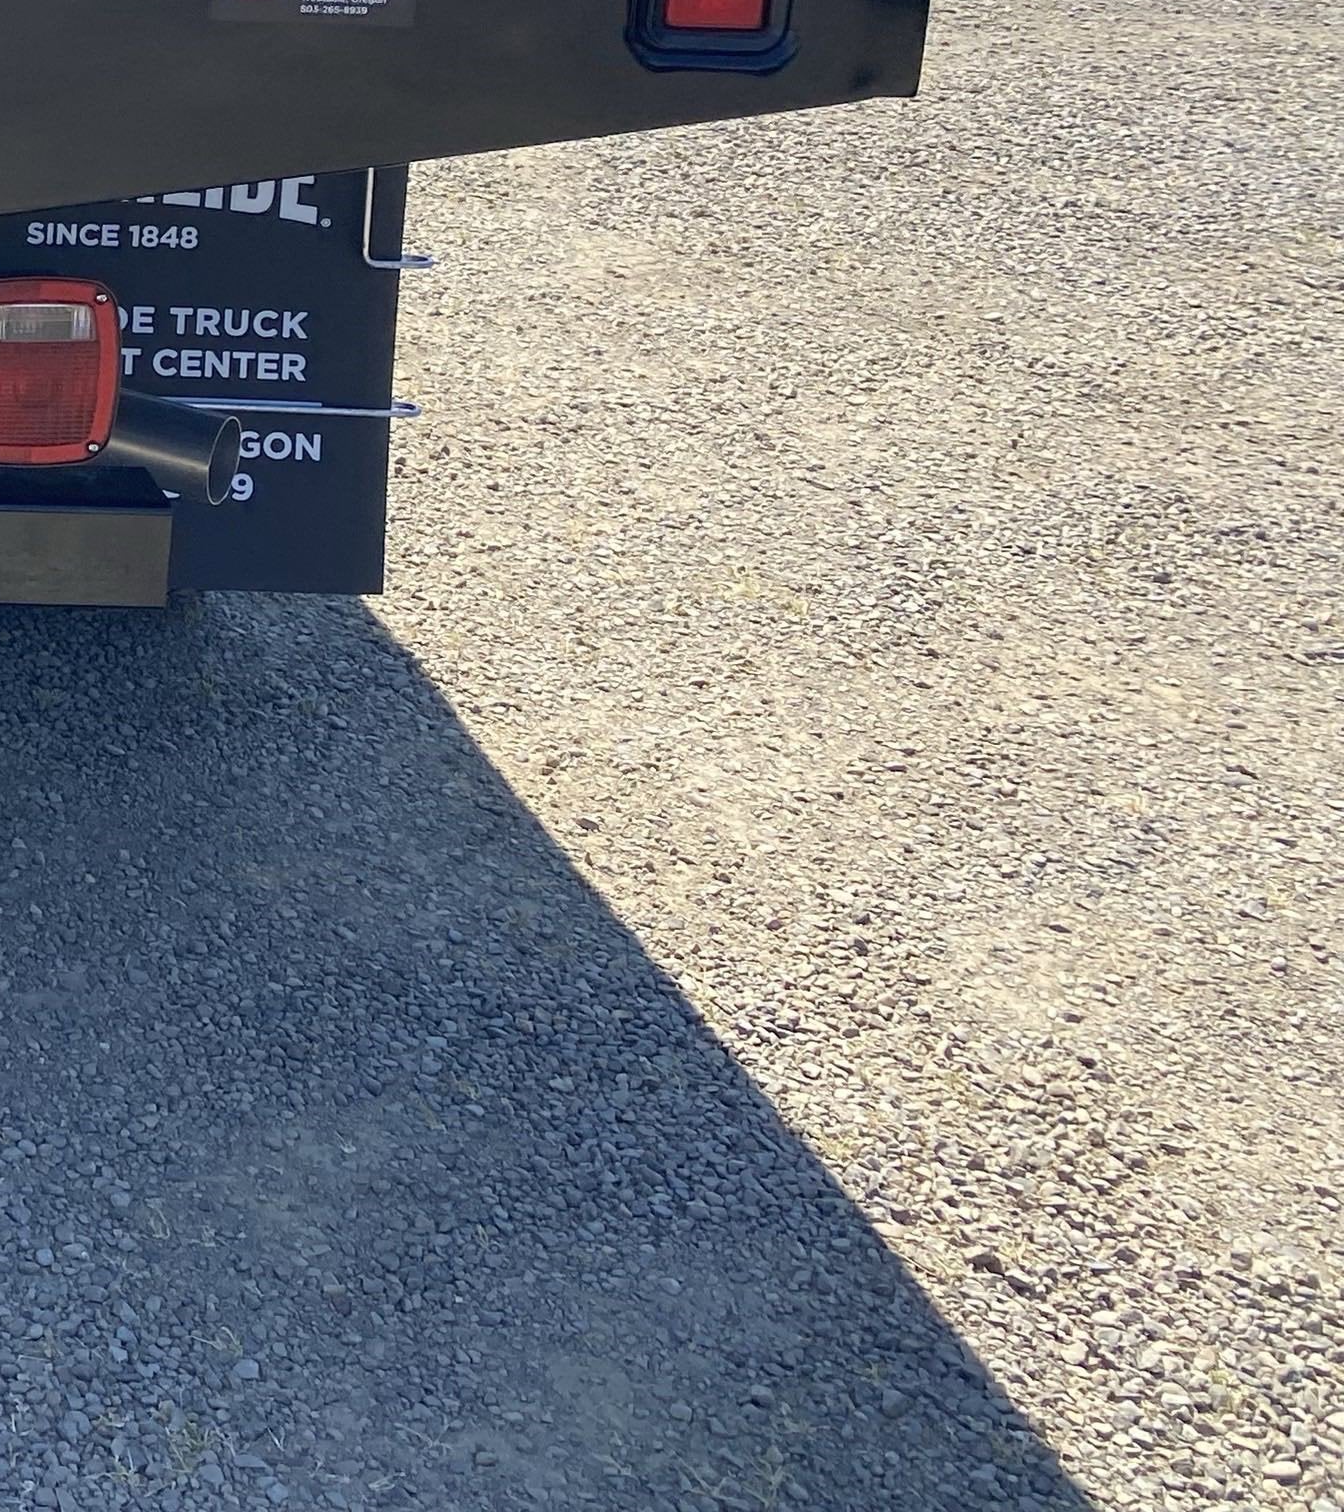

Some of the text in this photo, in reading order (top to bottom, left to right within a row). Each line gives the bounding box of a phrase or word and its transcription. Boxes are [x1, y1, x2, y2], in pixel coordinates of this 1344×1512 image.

[25, 221, 199, 250] SINCE 1848
[170, 307, 309, 341] TRUCK
[152, 348, 308, 382] CENTER
